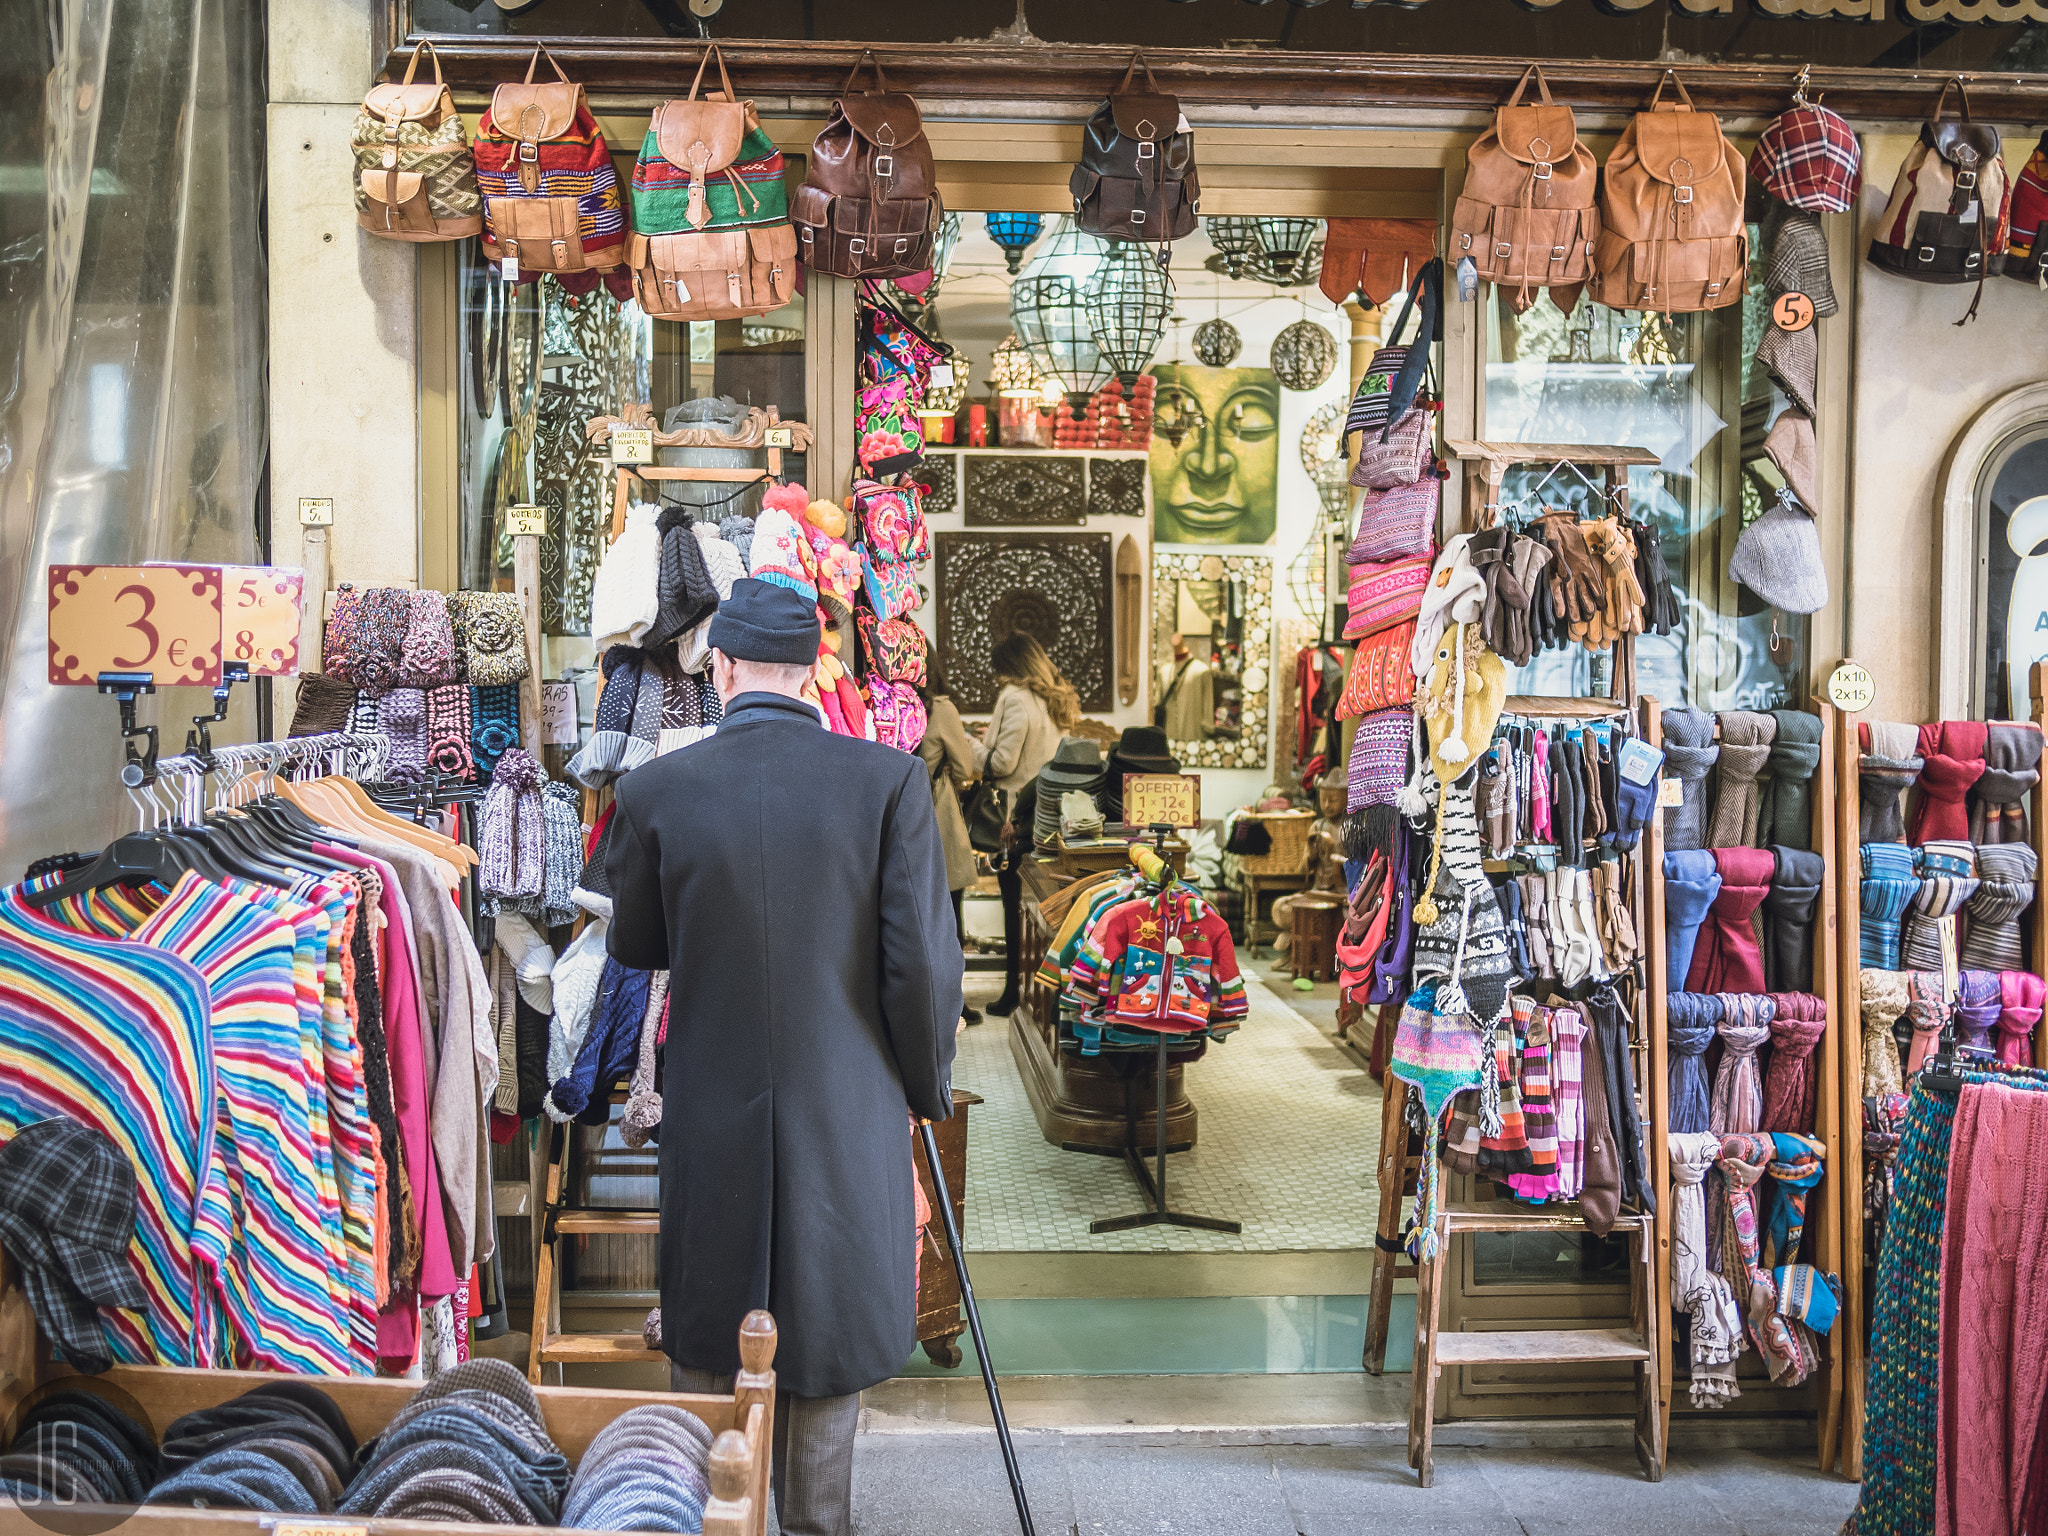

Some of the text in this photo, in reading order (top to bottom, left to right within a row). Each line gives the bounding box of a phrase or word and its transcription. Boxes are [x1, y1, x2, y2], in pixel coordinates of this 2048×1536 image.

[1781, 295, 1809, 326] 5€
[237, 579, 267, 608] 5€
[112, 584, 188, 669] 3€
[234, 630, 265, 660] 8€
[1134, 782, 1191, 793] OFERTA
